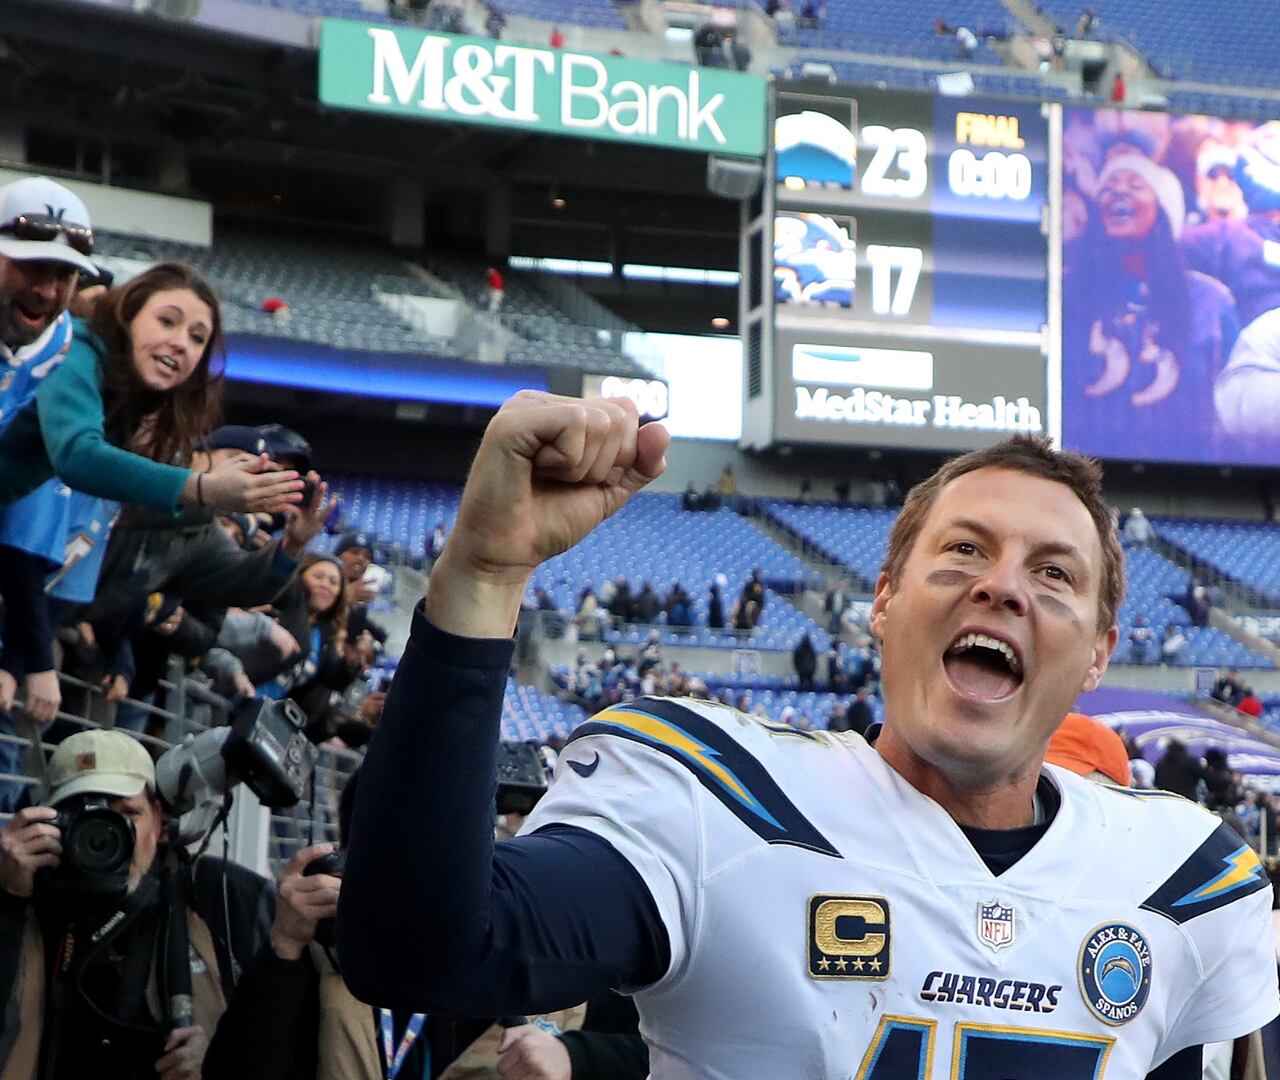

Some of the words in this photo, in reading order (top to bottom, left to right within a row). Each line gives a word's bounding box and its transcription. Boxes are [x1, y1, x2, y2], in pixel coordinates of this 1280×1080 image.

[368, 27, 555, 122] M&T
[561, 51, 727, 145] Bank
[956, 113, 1025, 149] FINAL
[861, 125, 927, 198] 23
[949, 149, 1032, 201] 0:00
[866, 245, 923, 318] 17
[794, 386, 928, 429] MedStar
[932, 395, 1042, 432] Health
[815, 899, 887, 955] C
[983, 919, 1010, 941] NFL
[1087, 927, 1117, 959] ALEX
[1117, 927, 1129, 941] &
[1130, 931, 1151, 968] FAYE
[920, 971, 1063, 1014] CHARGERS
[1095, 998, 1138, 1020] SPANOS
